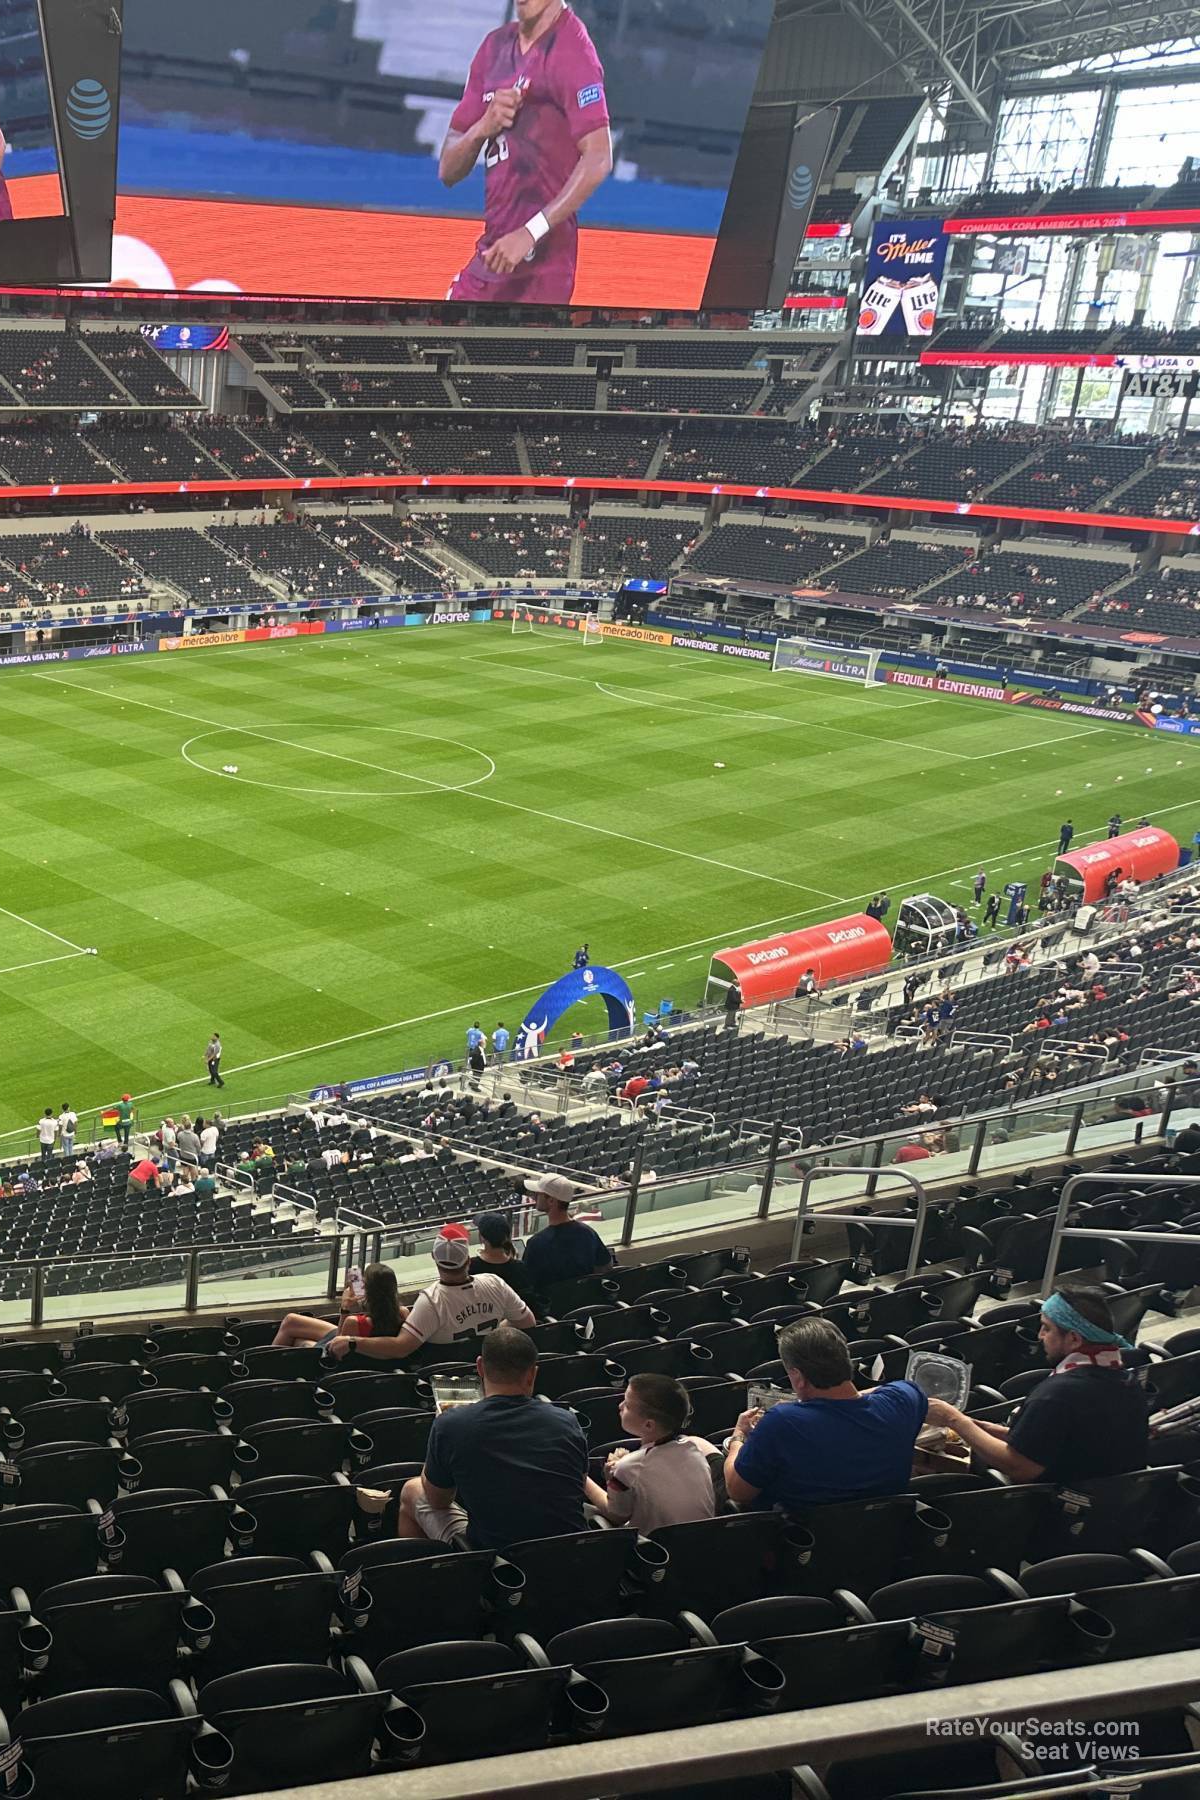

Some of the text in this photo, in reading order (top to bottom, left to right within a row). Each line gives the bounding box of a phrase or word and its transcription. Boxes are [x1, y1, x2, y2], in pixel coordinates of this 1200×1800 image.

[889, 233, 906, 243] IT'S
[877, 238, 937, 263] Miller
[904, 252, 934, 264] TIME
[865, 289, 891, 308] Lite
[911, 291, 936, 310] Lite
[1158, 358, 1178, 366] USA
[1124, 374, 1192, 398] AT&T
[433, 612, 470, 624] Degree
[183, 632, 238, 647] mercado libre
[603, 624, 664, 643] mercado libre
[117, 643, 145, 653] ULTRA
[673, 637, 718, 652] POWERADE
[2, 655, 31, 664] AMERICA
[32, 653, 45, 661] USA
[46, 652, 60, 660] 2024
[722, 645, 771, 661] POWERADE
[831, 662, 866, 677] ULTRA
[893, 671, 1005, 700] TEQUILA CENTENARIO
[1031, 698, 1061, 710] INTER
[827, 926, 865, 944] Betano
[747, 946, 788, 965] Betano
[455, 1302, 494, 1324] SKELTON
